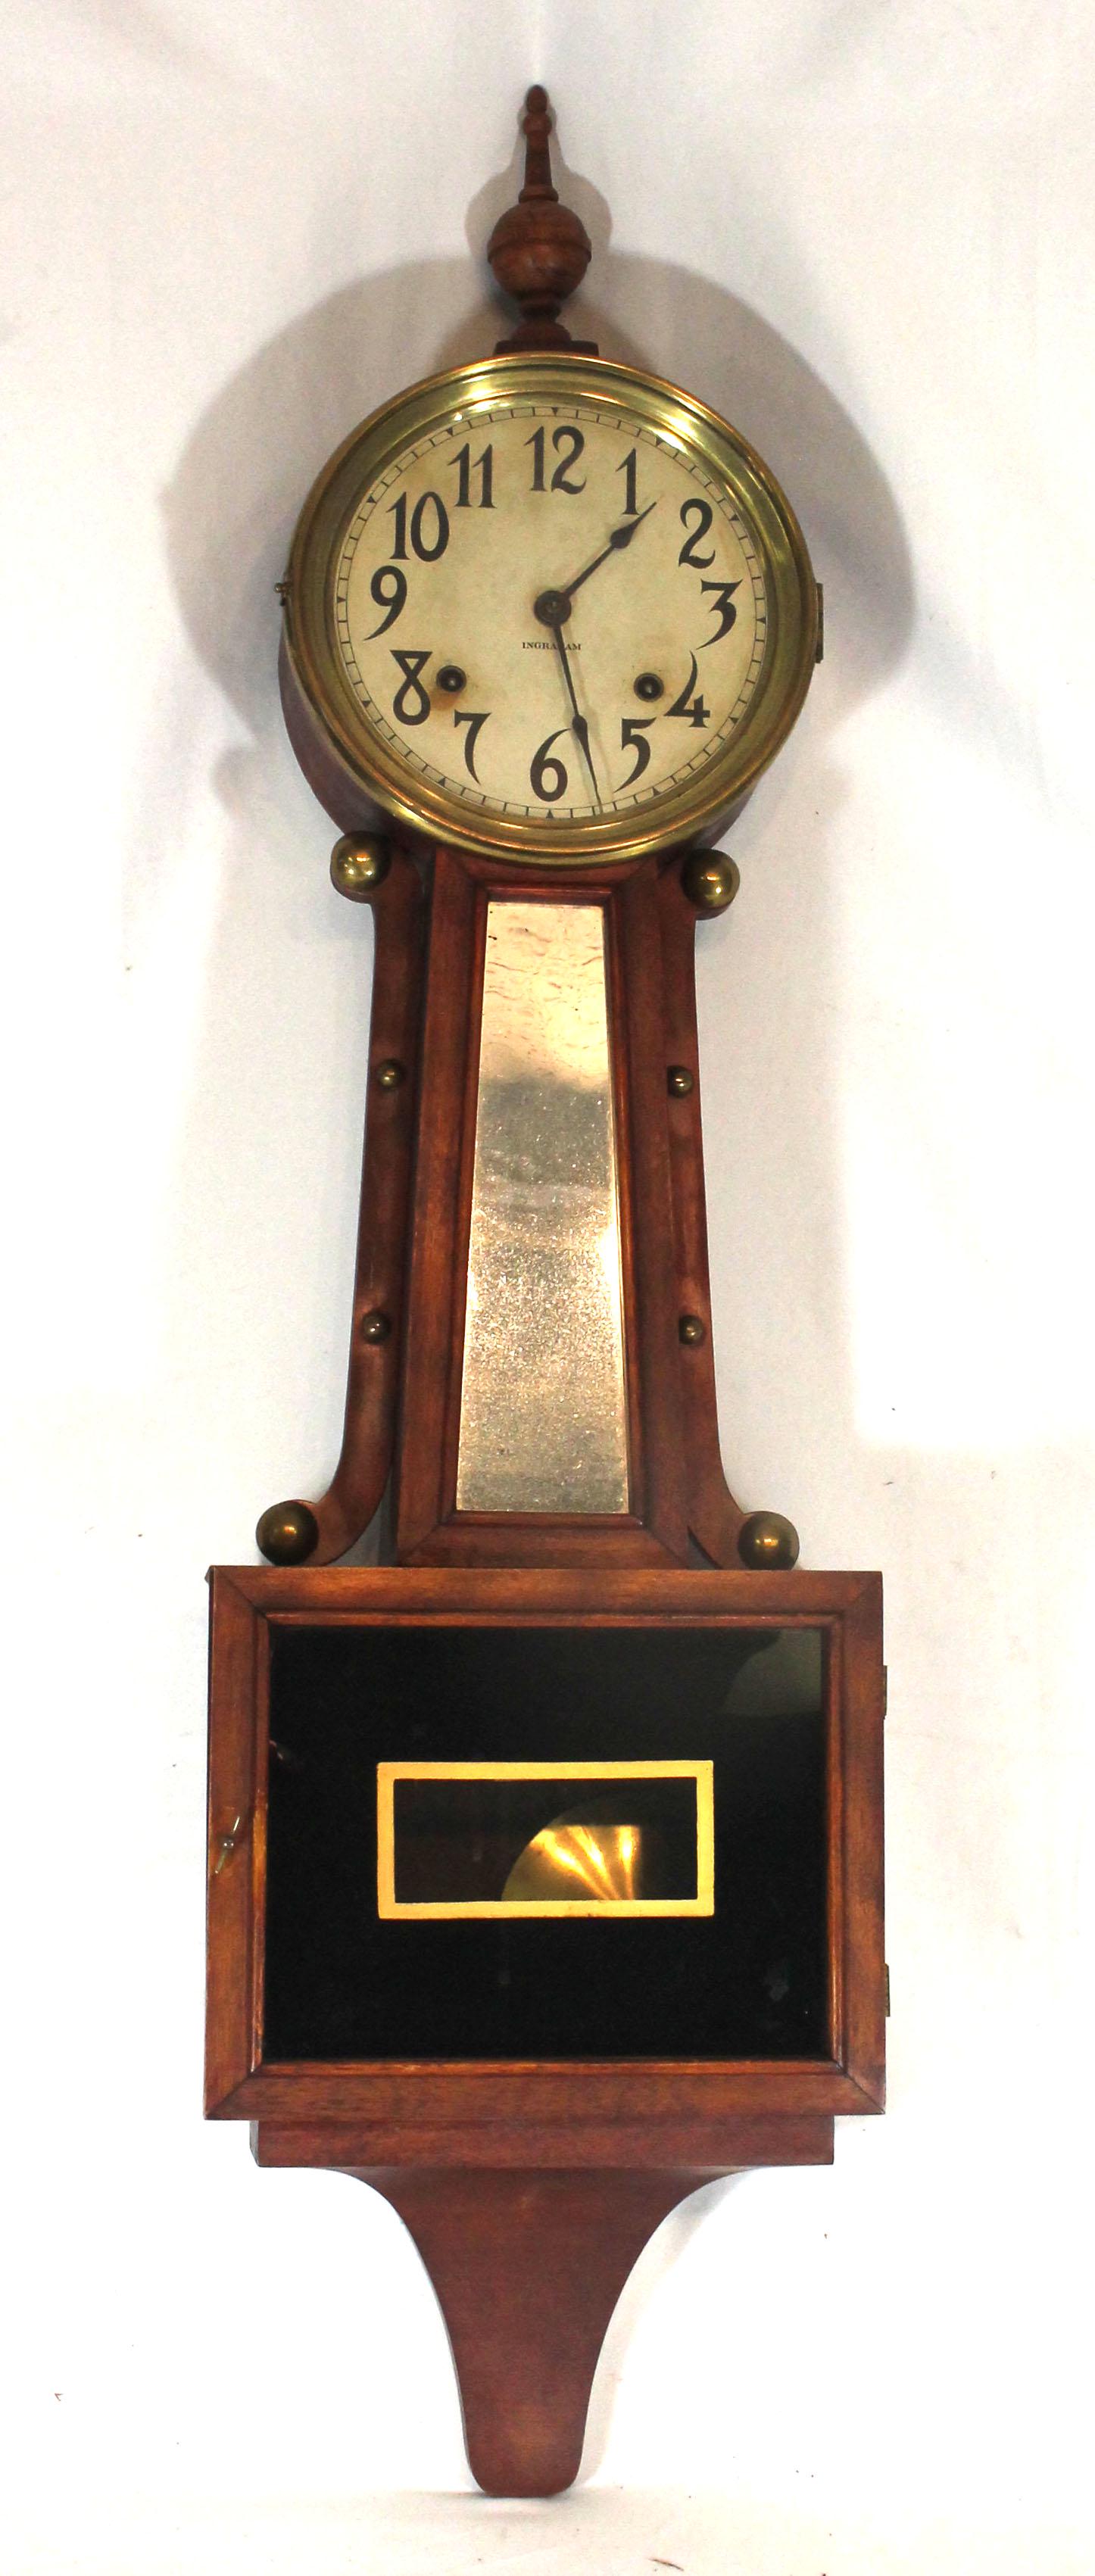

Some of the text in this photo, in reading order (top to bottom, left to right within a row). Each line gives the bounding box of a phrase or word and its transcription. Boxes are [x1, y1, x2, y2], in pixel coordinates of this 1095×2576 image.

[448, 443, 495, 508] 11
[524, 426, 586, 494] 12
[616, 448, 639, 515] 1
[386, 491, 449, 562] 10
[679, 498, 715, 569] 2
[365, 566, 407, 640] 9
[698, 579, 742, 649] 3
[522, 641, 582, 650] INGRAAM
[390, 650, 435, 725] 8
[663, 652, 710, 728] 4
[454, 709, 491, 783] 7
[530, 728, 571, 802] 6
[615, 718, 656, 792] 5
